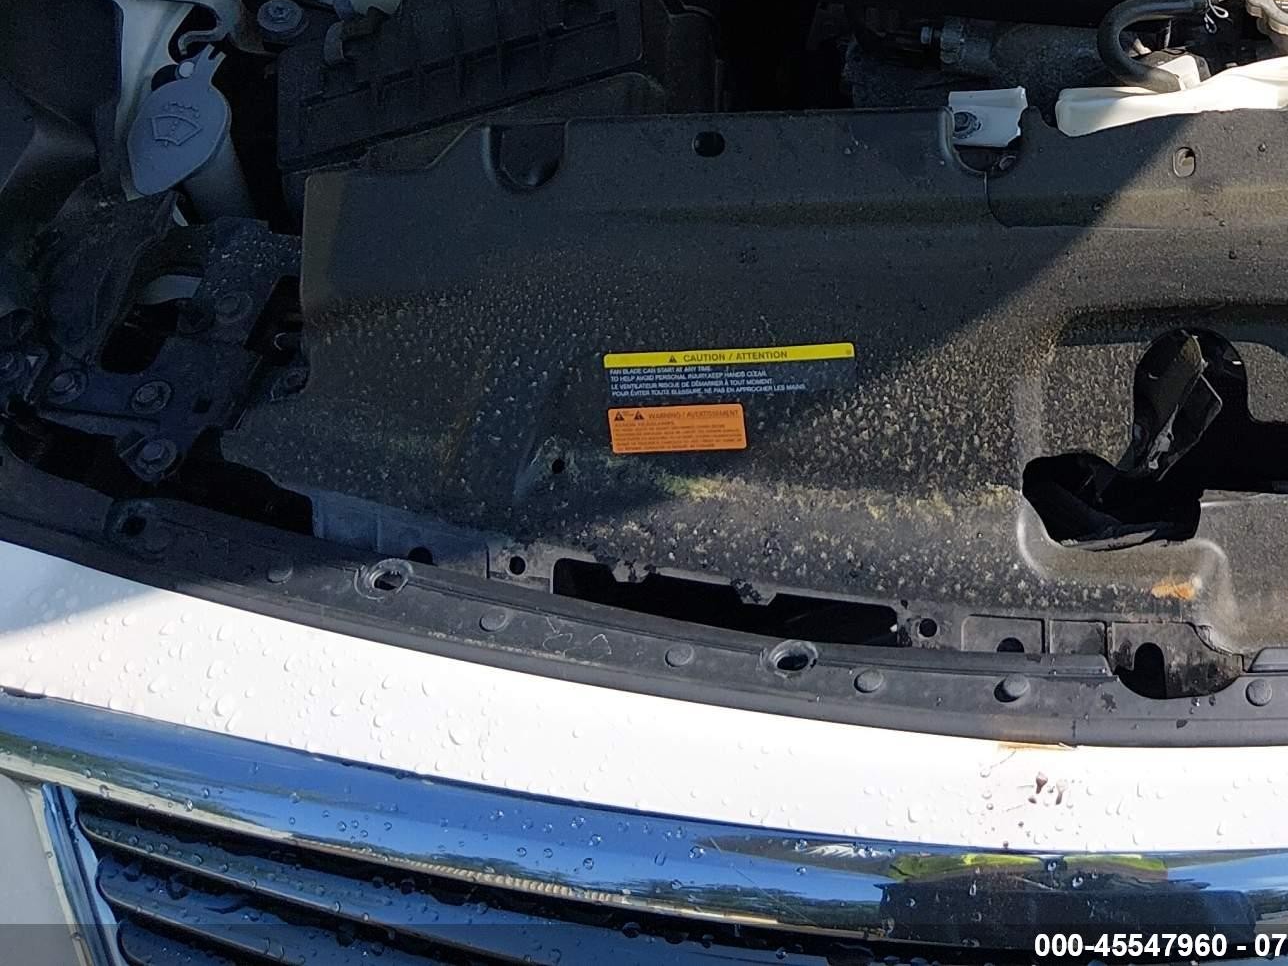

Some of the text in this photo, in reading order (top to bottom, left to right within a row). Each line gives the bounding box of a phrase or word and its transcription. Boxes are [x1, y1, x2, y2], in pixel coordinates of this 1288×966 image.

[683, 353, 725, 363] CAUTION
[736, 350, 787, 361] ATTENTION
[620, 382, 657, 390] VENTILATEUR
[630, 388, 650, 396] ÉVITER
[713, 386, 725, 394] PAS
[736, 385, 773, 393] APPROCHER
[774, 384, 785, 392] LES
[649, 411, 680, 419] WARNING
